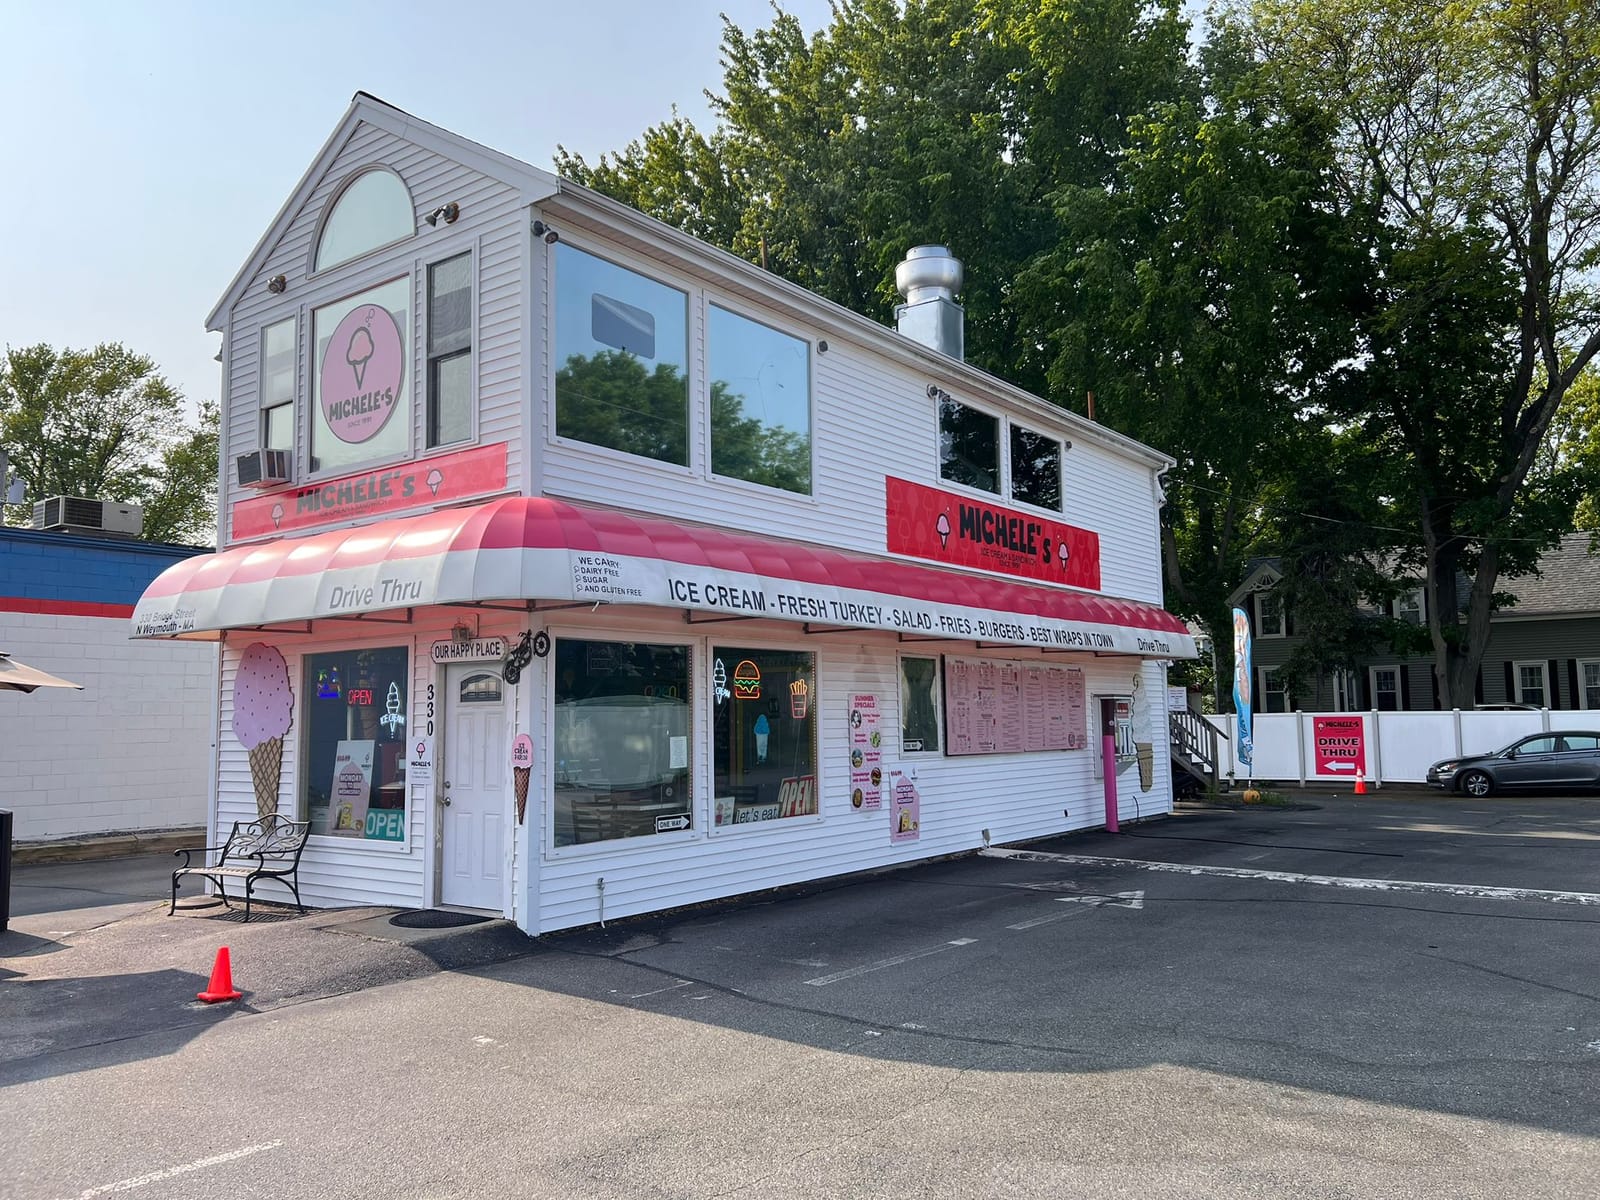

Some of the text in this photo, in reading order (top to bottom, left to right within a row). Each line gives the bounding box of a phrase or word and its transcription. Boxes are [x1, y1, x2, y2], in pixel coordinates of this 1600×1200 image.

[329, 386, 393, 422] MICHELE'S
[296, 471, 415, 515] MICHELE'S
[959, 504, 1051, 564] MICHELE'S
[578, 557, 593, 566] WE
[580, 566, 621, 577] DAIRY FREE
[582, 576, 608, 584] SUGAR
[329, 579, 422, 609] Drive Thru
[584, 585, 642, 597] AND GLUTEN FREE
[174, 608, 196, 619] Street
[668, 578, 700, 603] ICE
[704, 584, 766, 611] CREAM
[777, 594, 828, 618] FRESH
[829, 601, 882, 625] TURKEY
[892, 609, 932, 630] SALAD
[939, 615, 971, 634] FRIES
[978, 620, 1025, 640] BURGERS
[1030, 626, 1051, 643] BEST
[1053, 629, 1083, 646] WRAPS
[1083, 632, 1092, 647] IN
[1091, 632, 1114, 648] TOWN
[136, 625, 142, 635] N
[143, 621, 177, 636] Weymouth
[182, 619, 194, 630] MA
[435, 641, 500, 659] OUR HAPPY PLACE
[1137, 637, 1170, 653] Drive Thru
[347, 690, 373, 705] OPEN
[1319, 738, 1359, 746] DRIVE
[1321, 749, 1356, 757] THRU
[779, 780, 813, 816] OPEN
[735, 807, 759, 824] let's
[761, 806, 778, 820] eat
[365, 812, 404, 838] OPEN
[660, 820, 682, 829] ONE WAY
